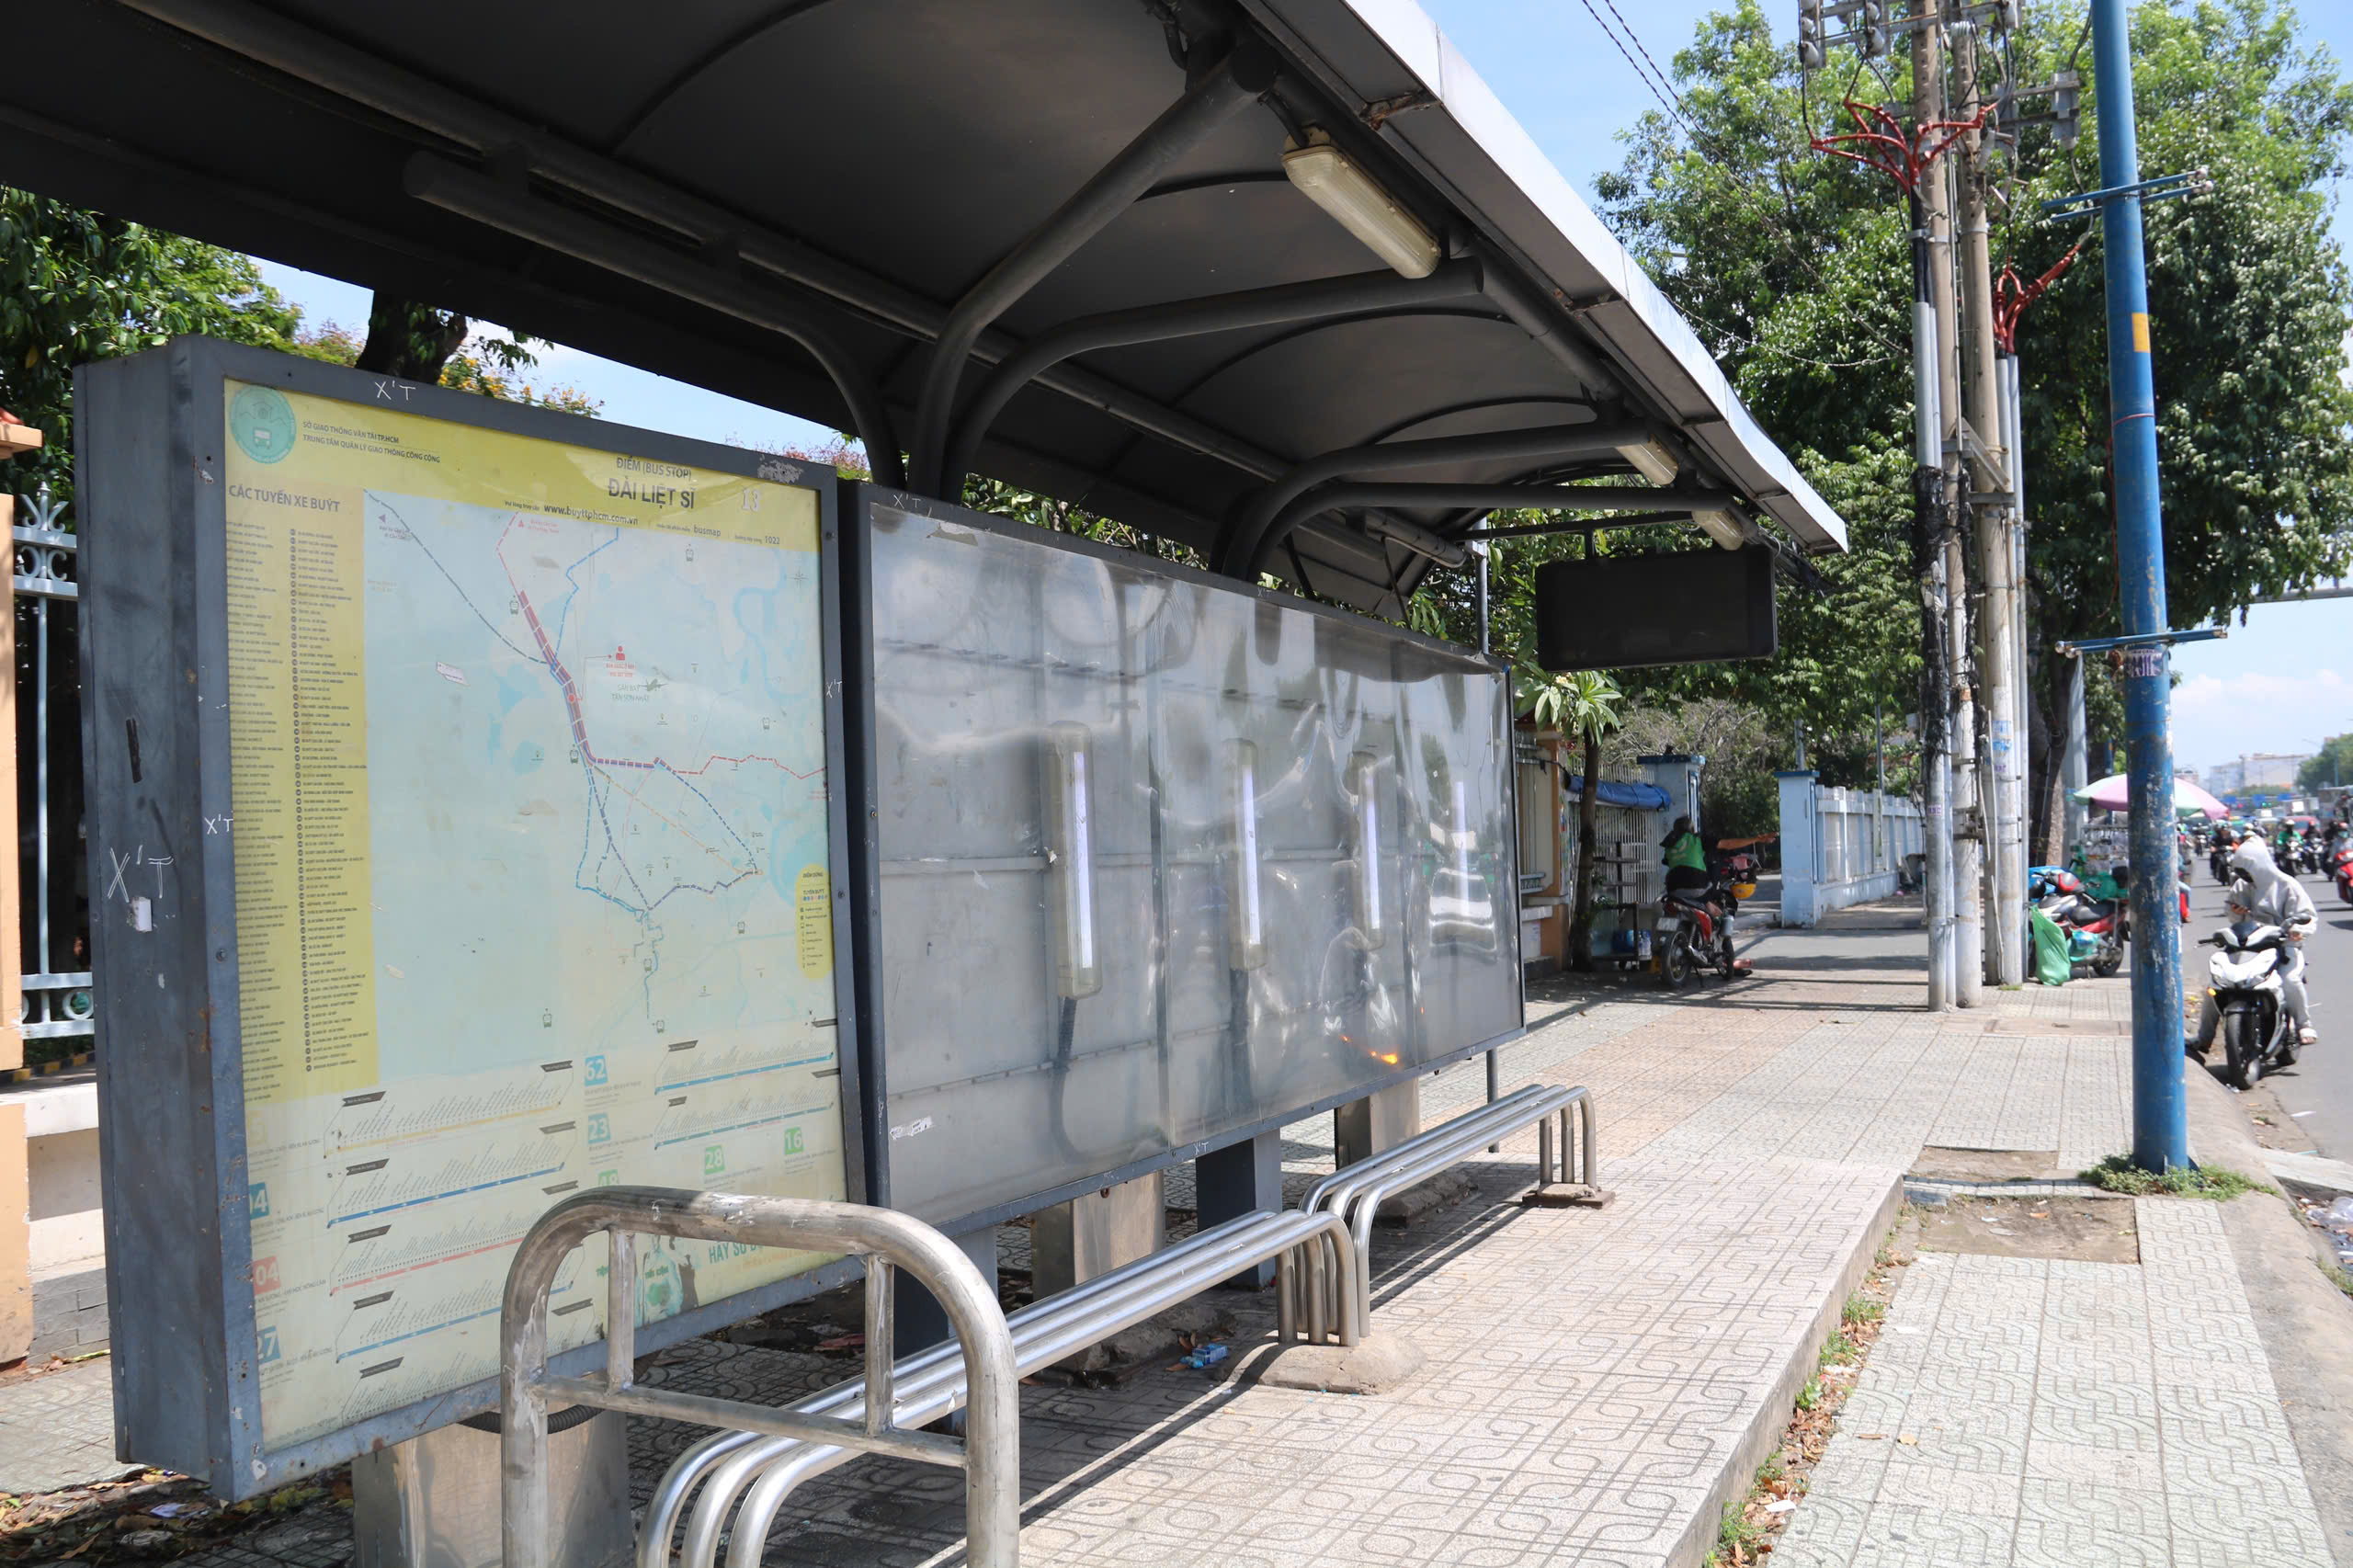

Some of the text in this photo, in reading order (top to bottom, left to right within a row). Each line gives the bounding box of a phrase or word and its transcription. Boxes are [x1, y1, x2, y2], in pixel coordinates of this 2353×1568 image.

[313, 423, 329, 433] GIAO
[330, 425, 353, 437] THÔNG
[378, 433, 399, 444] TP.HCM
[303, 434, 325, 445] TRUNG
[325, 437, 340, 447] TÂM
[368, 445, 383, 455] GIAO
[383, 447, 405, 459] THÔNG
[642, 461, 664, 476] (BUS
[665, 465, 692, 482] STOP)
[228, 484, 340, 513] CÁC TUYẾN XE BUÝT
[642, 483, 677, 509] LIỆT
[742, 488, 761, 512] 13
[543, 505, 638, 526] www.buyttphcm.com.vn
[693, 524, 722, 539] busmap
[765, 535, 780, 545] 1022
[585, 1058, 607, 1081] 62
[588, 1118, 608, 1141] 23
[786, 1131, 802, 1150] 16
[705, 1149, 723, 1169] 28
